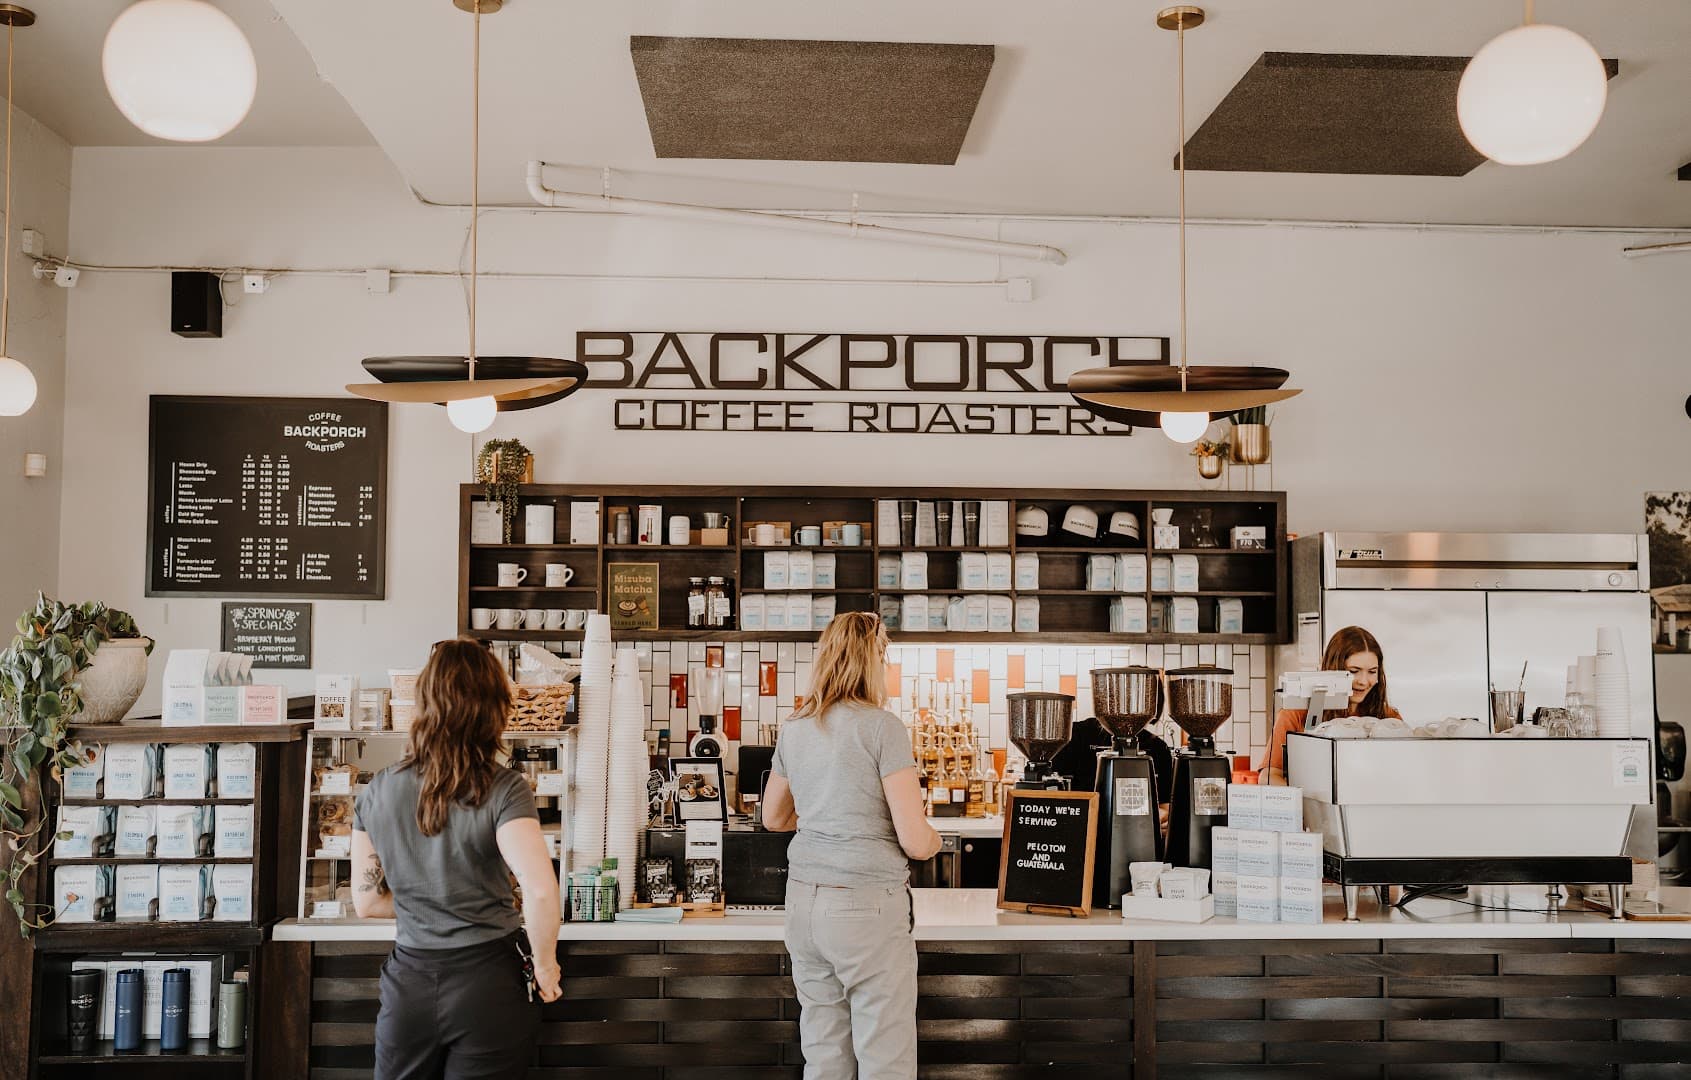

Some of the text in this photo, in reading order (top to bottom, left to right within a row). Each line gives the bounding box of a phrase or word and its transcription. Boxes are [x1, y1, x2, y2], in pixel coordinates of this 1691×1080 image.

[576, 332, 1170, 392] BACKPORCH
[308, 412, 342, 423] COFFEE
[614, 399, 814, 431] COFFEE
[284, 426, 366, 438] BACKPORCH
[305, 440, 345, 452] ROASTERS
[614, 575, 652, 583] Mizuba
[614, 585, 653, 593] Matcha
[248, 607, 282, 619] SPRING
[241, 620, 293, 631] SPECIALS
[1020, 805, 1081, 816] TODAY WE'RE
[1018, 817, 1057, 826] SERVING
[1032, 853, 1050, 862] AND
[1017, 859, 1065, 871] GUATEMALA
